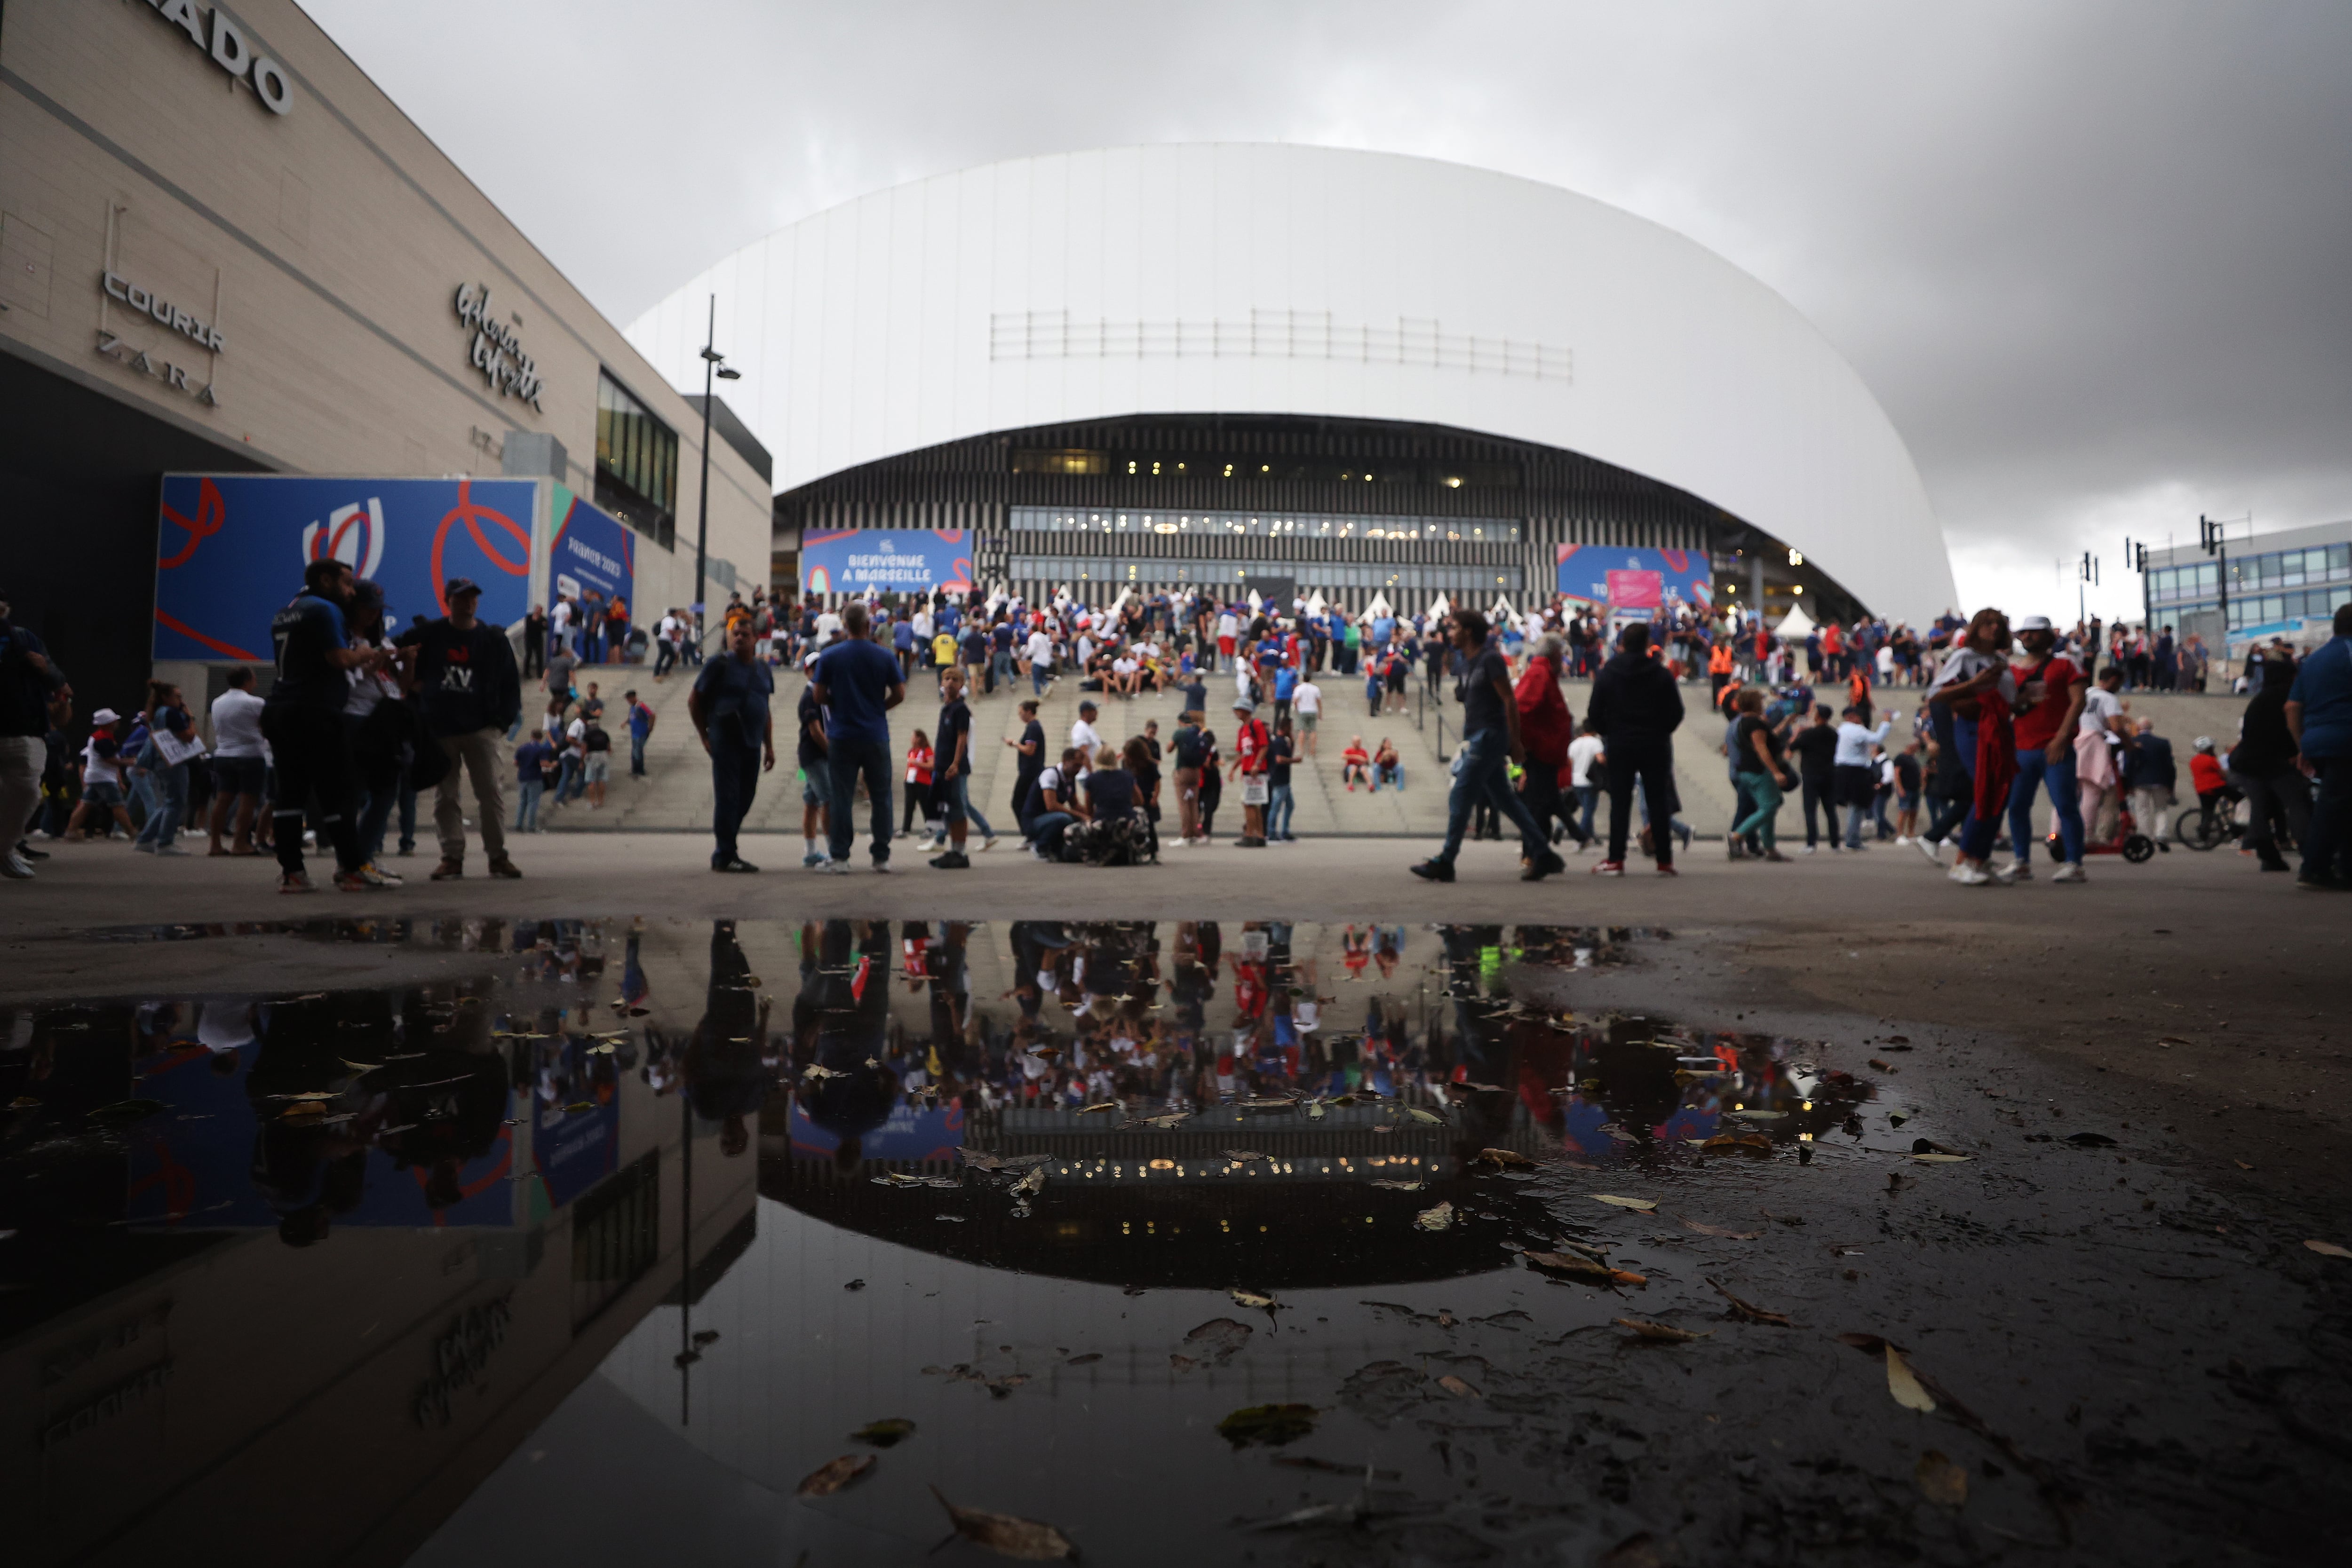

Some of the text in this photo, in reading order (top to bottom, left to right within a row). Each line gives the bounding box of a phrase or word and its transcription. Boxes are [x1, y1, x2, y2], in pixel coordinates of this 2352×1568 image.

[146, 0, 294, 116] ADO
[103, 271, 224, 354] COURIR
[97, 330, 221, 407] ZARA
[842, 568, 931, 583] A MARSEILLE
[848, 554, 925, 568] BIENVENUE
[441, 665, 473, 688] XV
